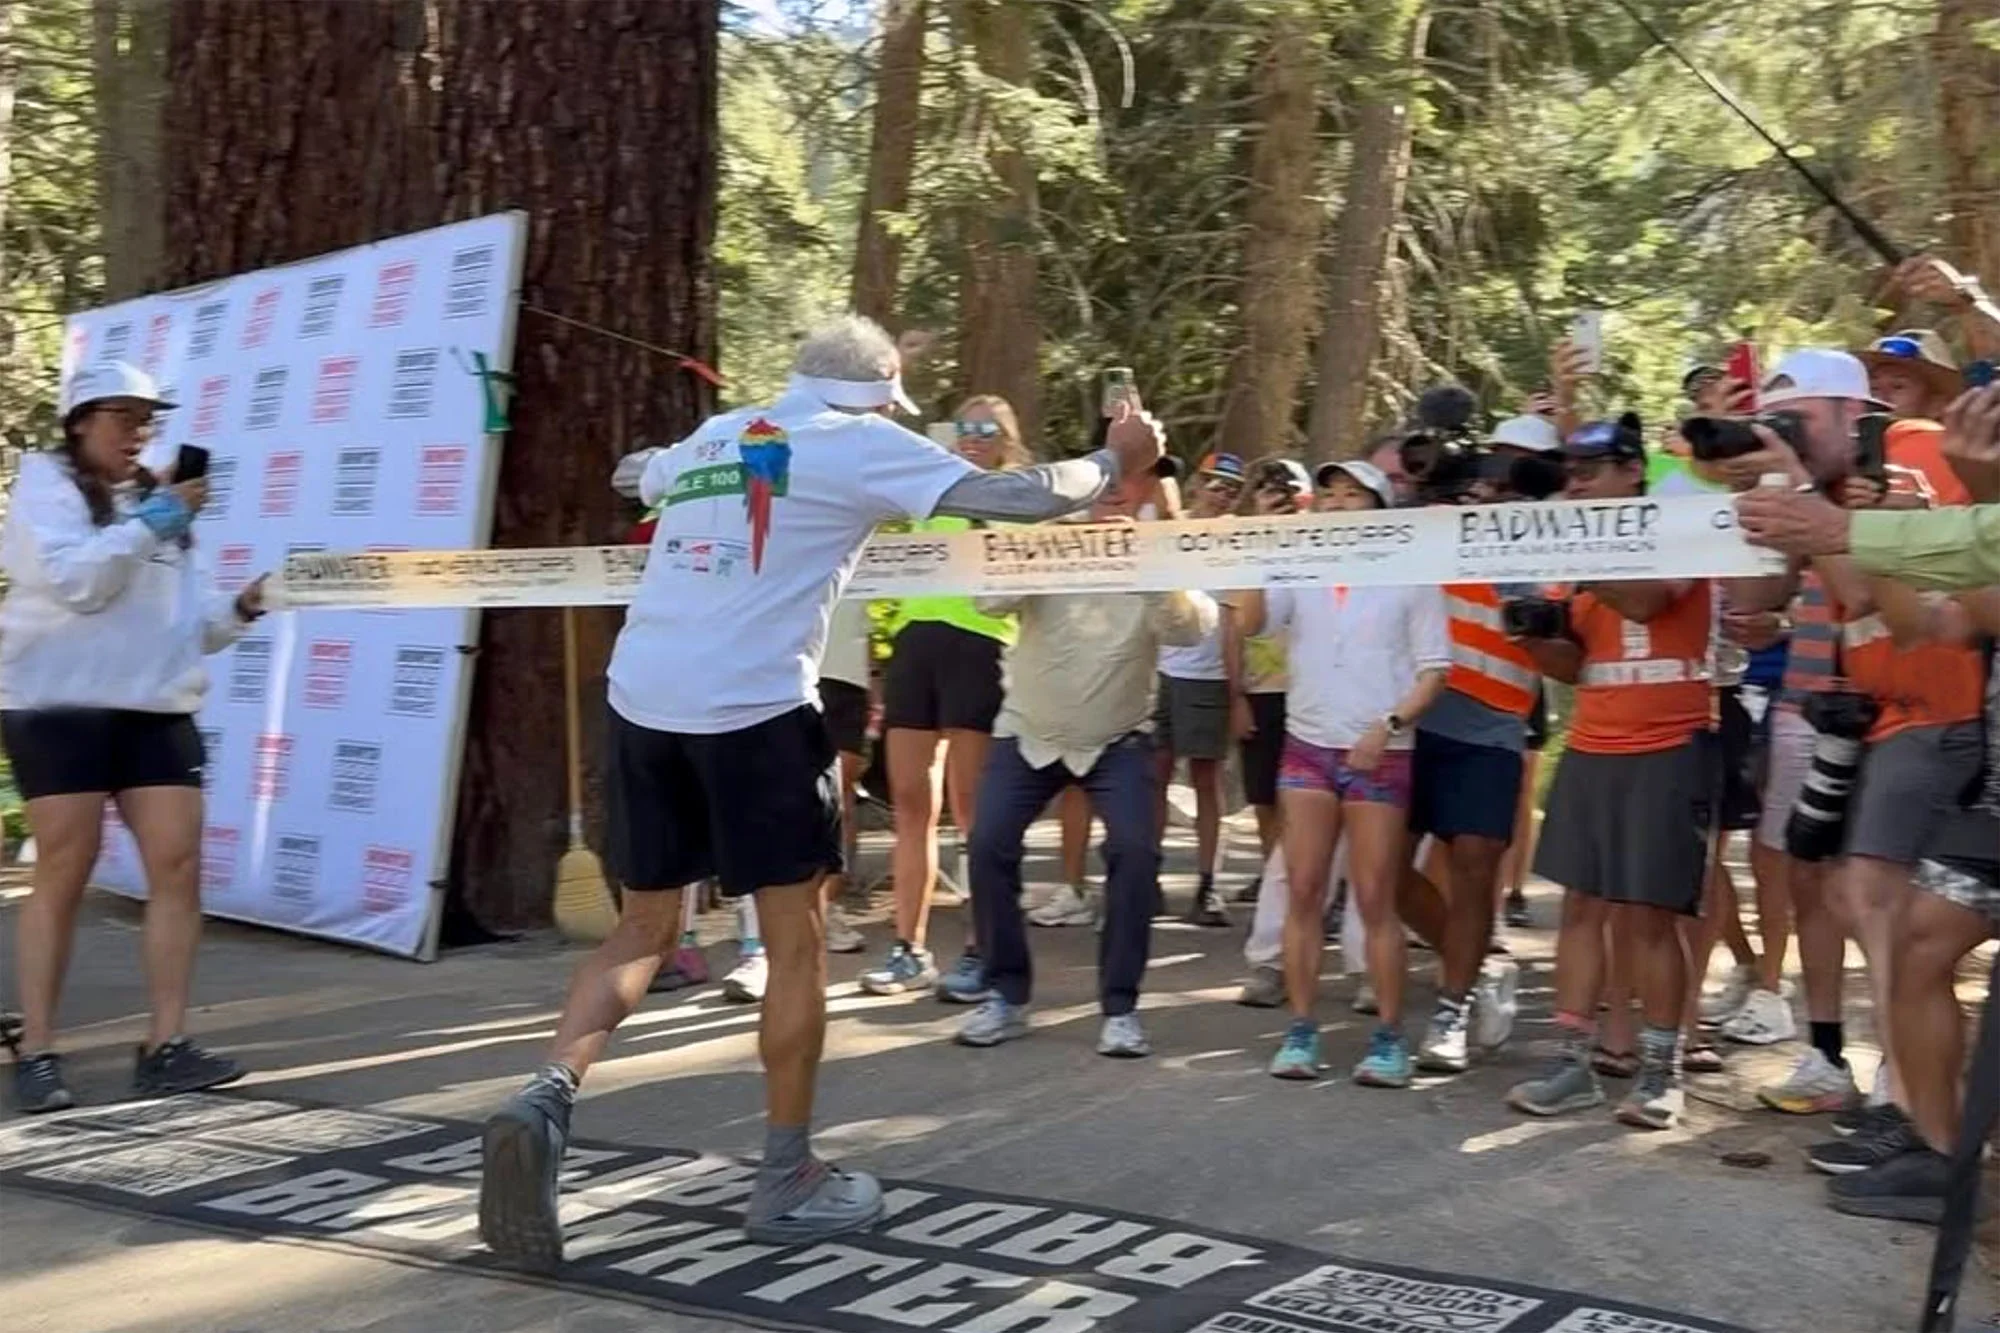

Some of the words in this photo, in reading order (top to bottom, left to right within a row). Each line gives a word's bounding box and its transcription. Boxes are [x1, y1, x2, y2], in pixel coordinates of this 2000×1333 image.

[710, 469, 740, 487] 100
[1458, 503, 1661, 544] BADWATER
[982, 529, 1136, 562] BADWATER
